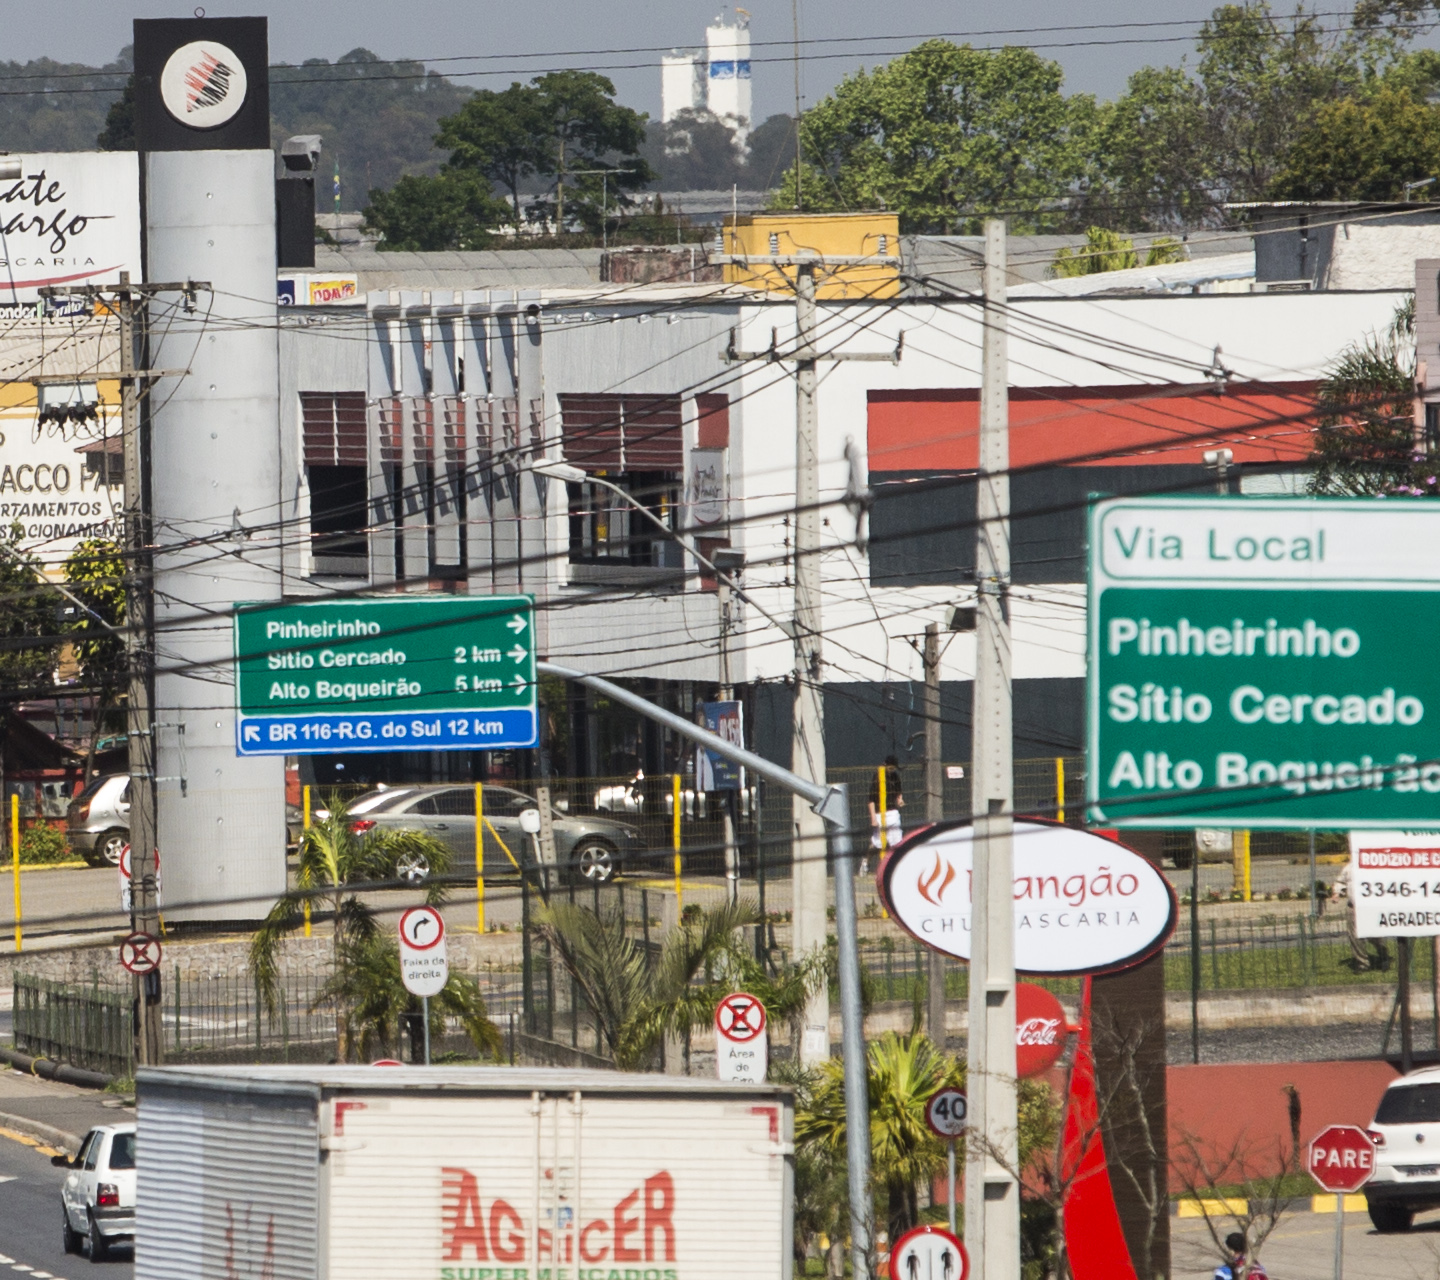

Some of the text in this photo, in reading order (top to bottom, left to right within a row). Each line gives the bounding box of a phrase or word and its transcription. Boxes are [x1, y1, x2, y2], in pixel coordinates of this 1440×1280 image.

[1112, 526, 1326, 561] Via Local
[267, 619, 381, 639] Pinheirinho
[1107, 618, 1361, 657] Pinheirinho
[319, 647, 407, 668] Cercado
[453, 646, 468, 664] 2
[473, 645, 502, 663] km
[269, 675, 503, 701] Alto Boqueirão 5 km
[1107, 684, 1213, 724] Sítio
[1229, 687, 1425, 725] Cercado
[269, 723, 298, 742] BR
[382, 721, 407, 738] do
[411, 719, 441, 738] Sul
[448, 719, 468, 736] 12
[474, 718, 504, 735] km
[1108, 751, 1204, 789] Alto
[1361, 849, 1412, 867] RODÍZIO
[1413, 851, 1430, 866] DE
[966, 865, 1109, 907] angão
[921, 910, 1110, 934] CHUASCARIA
[403, 955, 445, 968] Faixa da
[408, 970, 442, 981] direita
[728, 1046, 756, 1060] Área
[935, 1096, 967, 1121] 40
[1312, 1147, 1370, 1169] PARE
